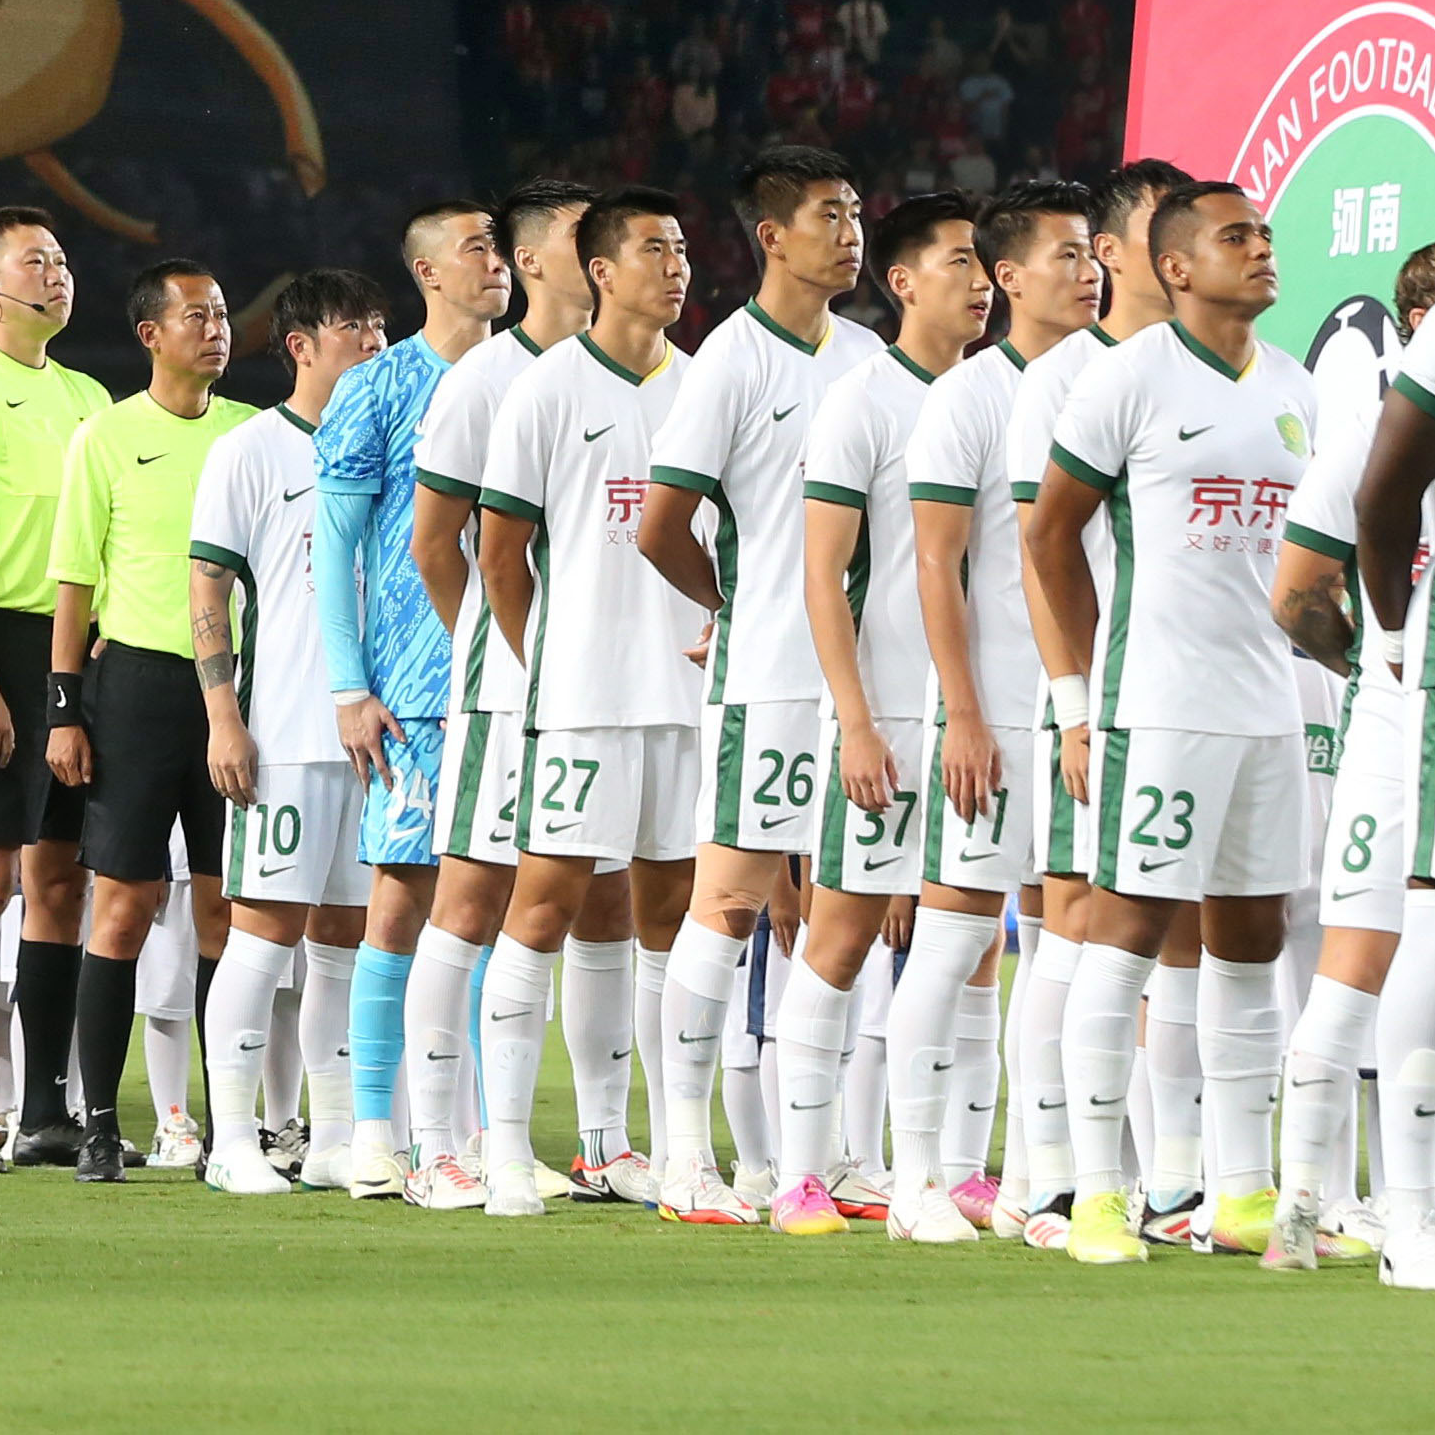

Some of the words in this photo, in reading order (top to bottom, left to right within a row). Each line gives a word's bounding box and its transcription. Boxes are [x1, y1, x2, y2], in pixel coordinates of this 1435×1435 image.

[1309, 38, 1435, 123] FOOTBA
[1329, 182, 1402, 258] 河南
[1187, 474, 1295, 530] 京东
[1184, 533, 1281, 555] 又好又便
[541, 756, 600, 813] 27
[753, 749, 815, 807] 26
[255, 804, 301, 857] 10
[856, 791, 918, 848] 37
[1129, 785, 1195, 850] 23
[1342, 814, 1378, 873] 8
